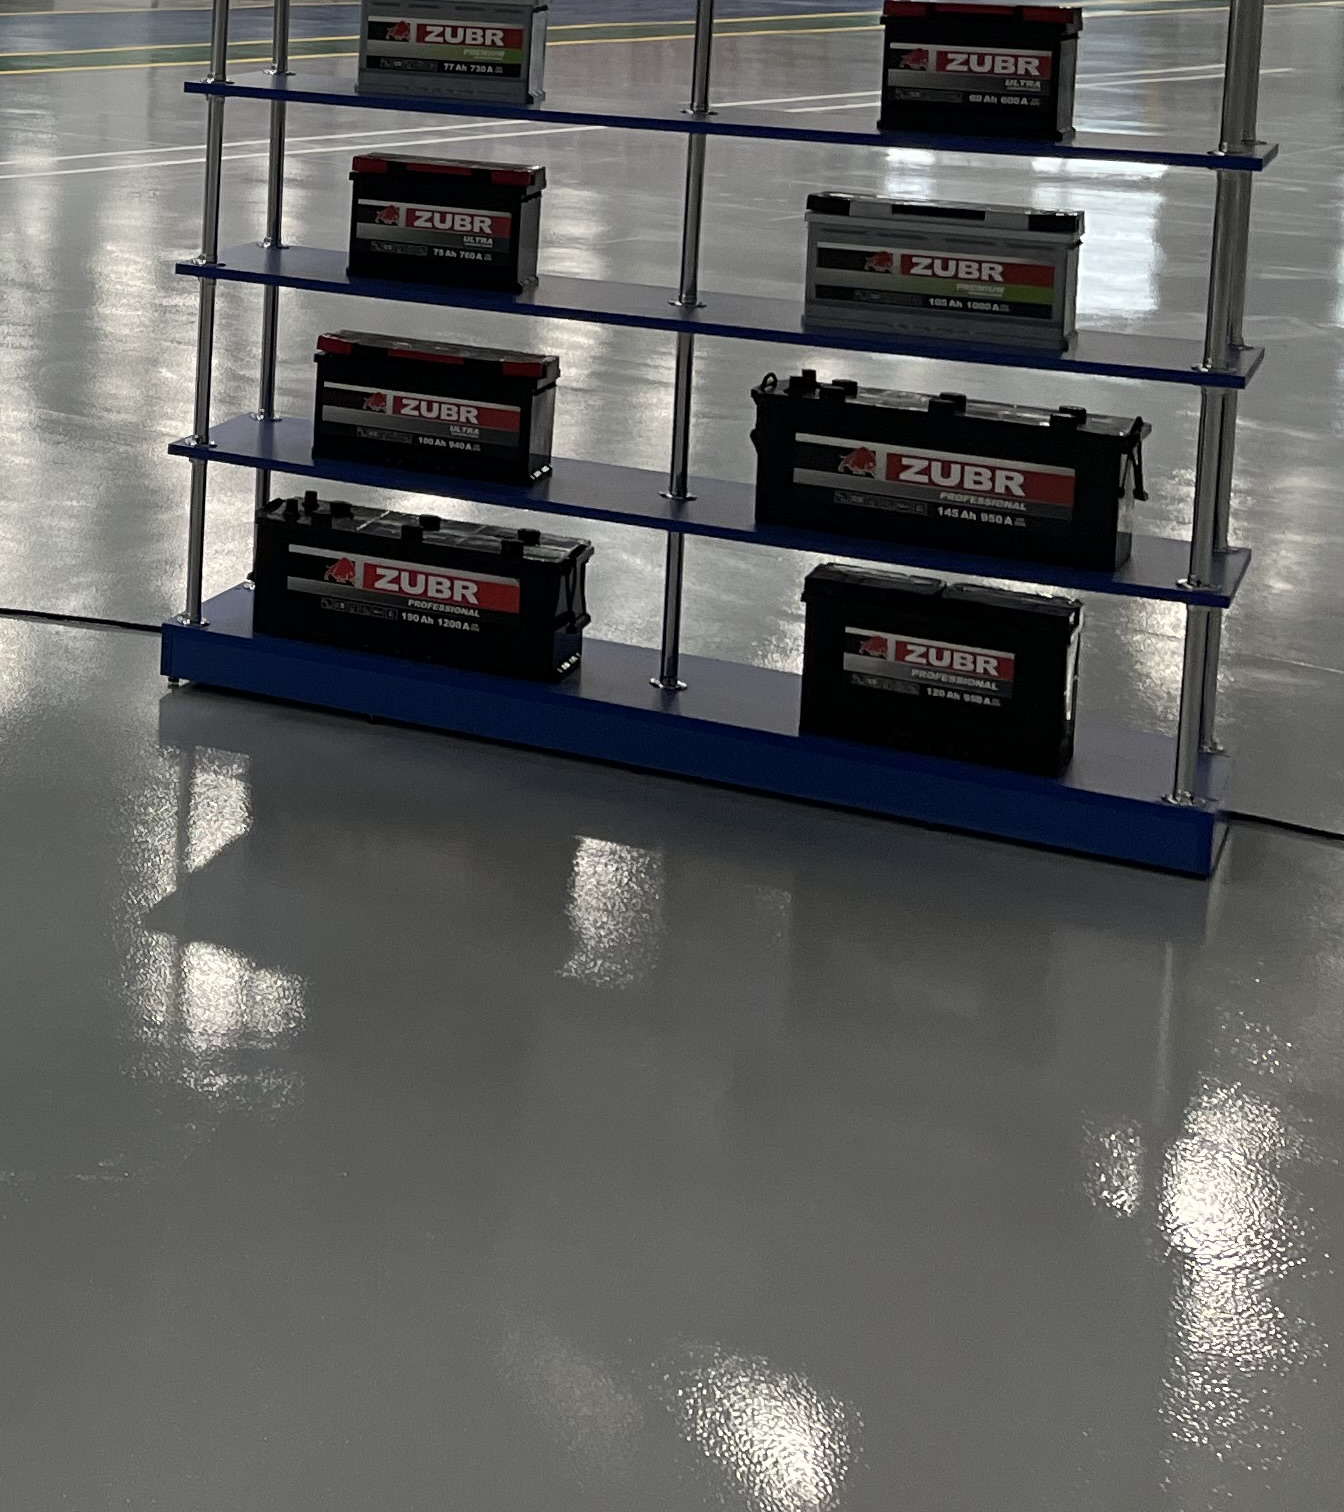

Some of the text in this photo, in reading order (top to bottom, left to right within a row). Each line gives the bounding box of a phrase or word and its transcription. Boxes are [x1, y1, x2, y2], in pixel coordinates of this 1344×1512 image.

[424, 25, 505, 47] ZUBR
[946, 52, 1041, 76] ZUBR
[1004, 78, 1042, 88] ULTRA
[413, 210, 493, 234] ZUBR
[463, 235, 493, 245] ULTRA
[910, 256, 1005, 282] ZUBR
[400, 398, 480, 425] ZUBR
[449, 425, 480, 436] ULTRA
[898, 457, 1027, 497] ZUBR
[939, 491, 1028, 512] PROFESSIONAL
[374, 567, 480, 605] ZUBR
[407, 599, 482, 619] PROFESSIONAL
[904, 644, 1000, 677] ZUBR
[911, 669, 1000, 691] PROFESSIONAL
